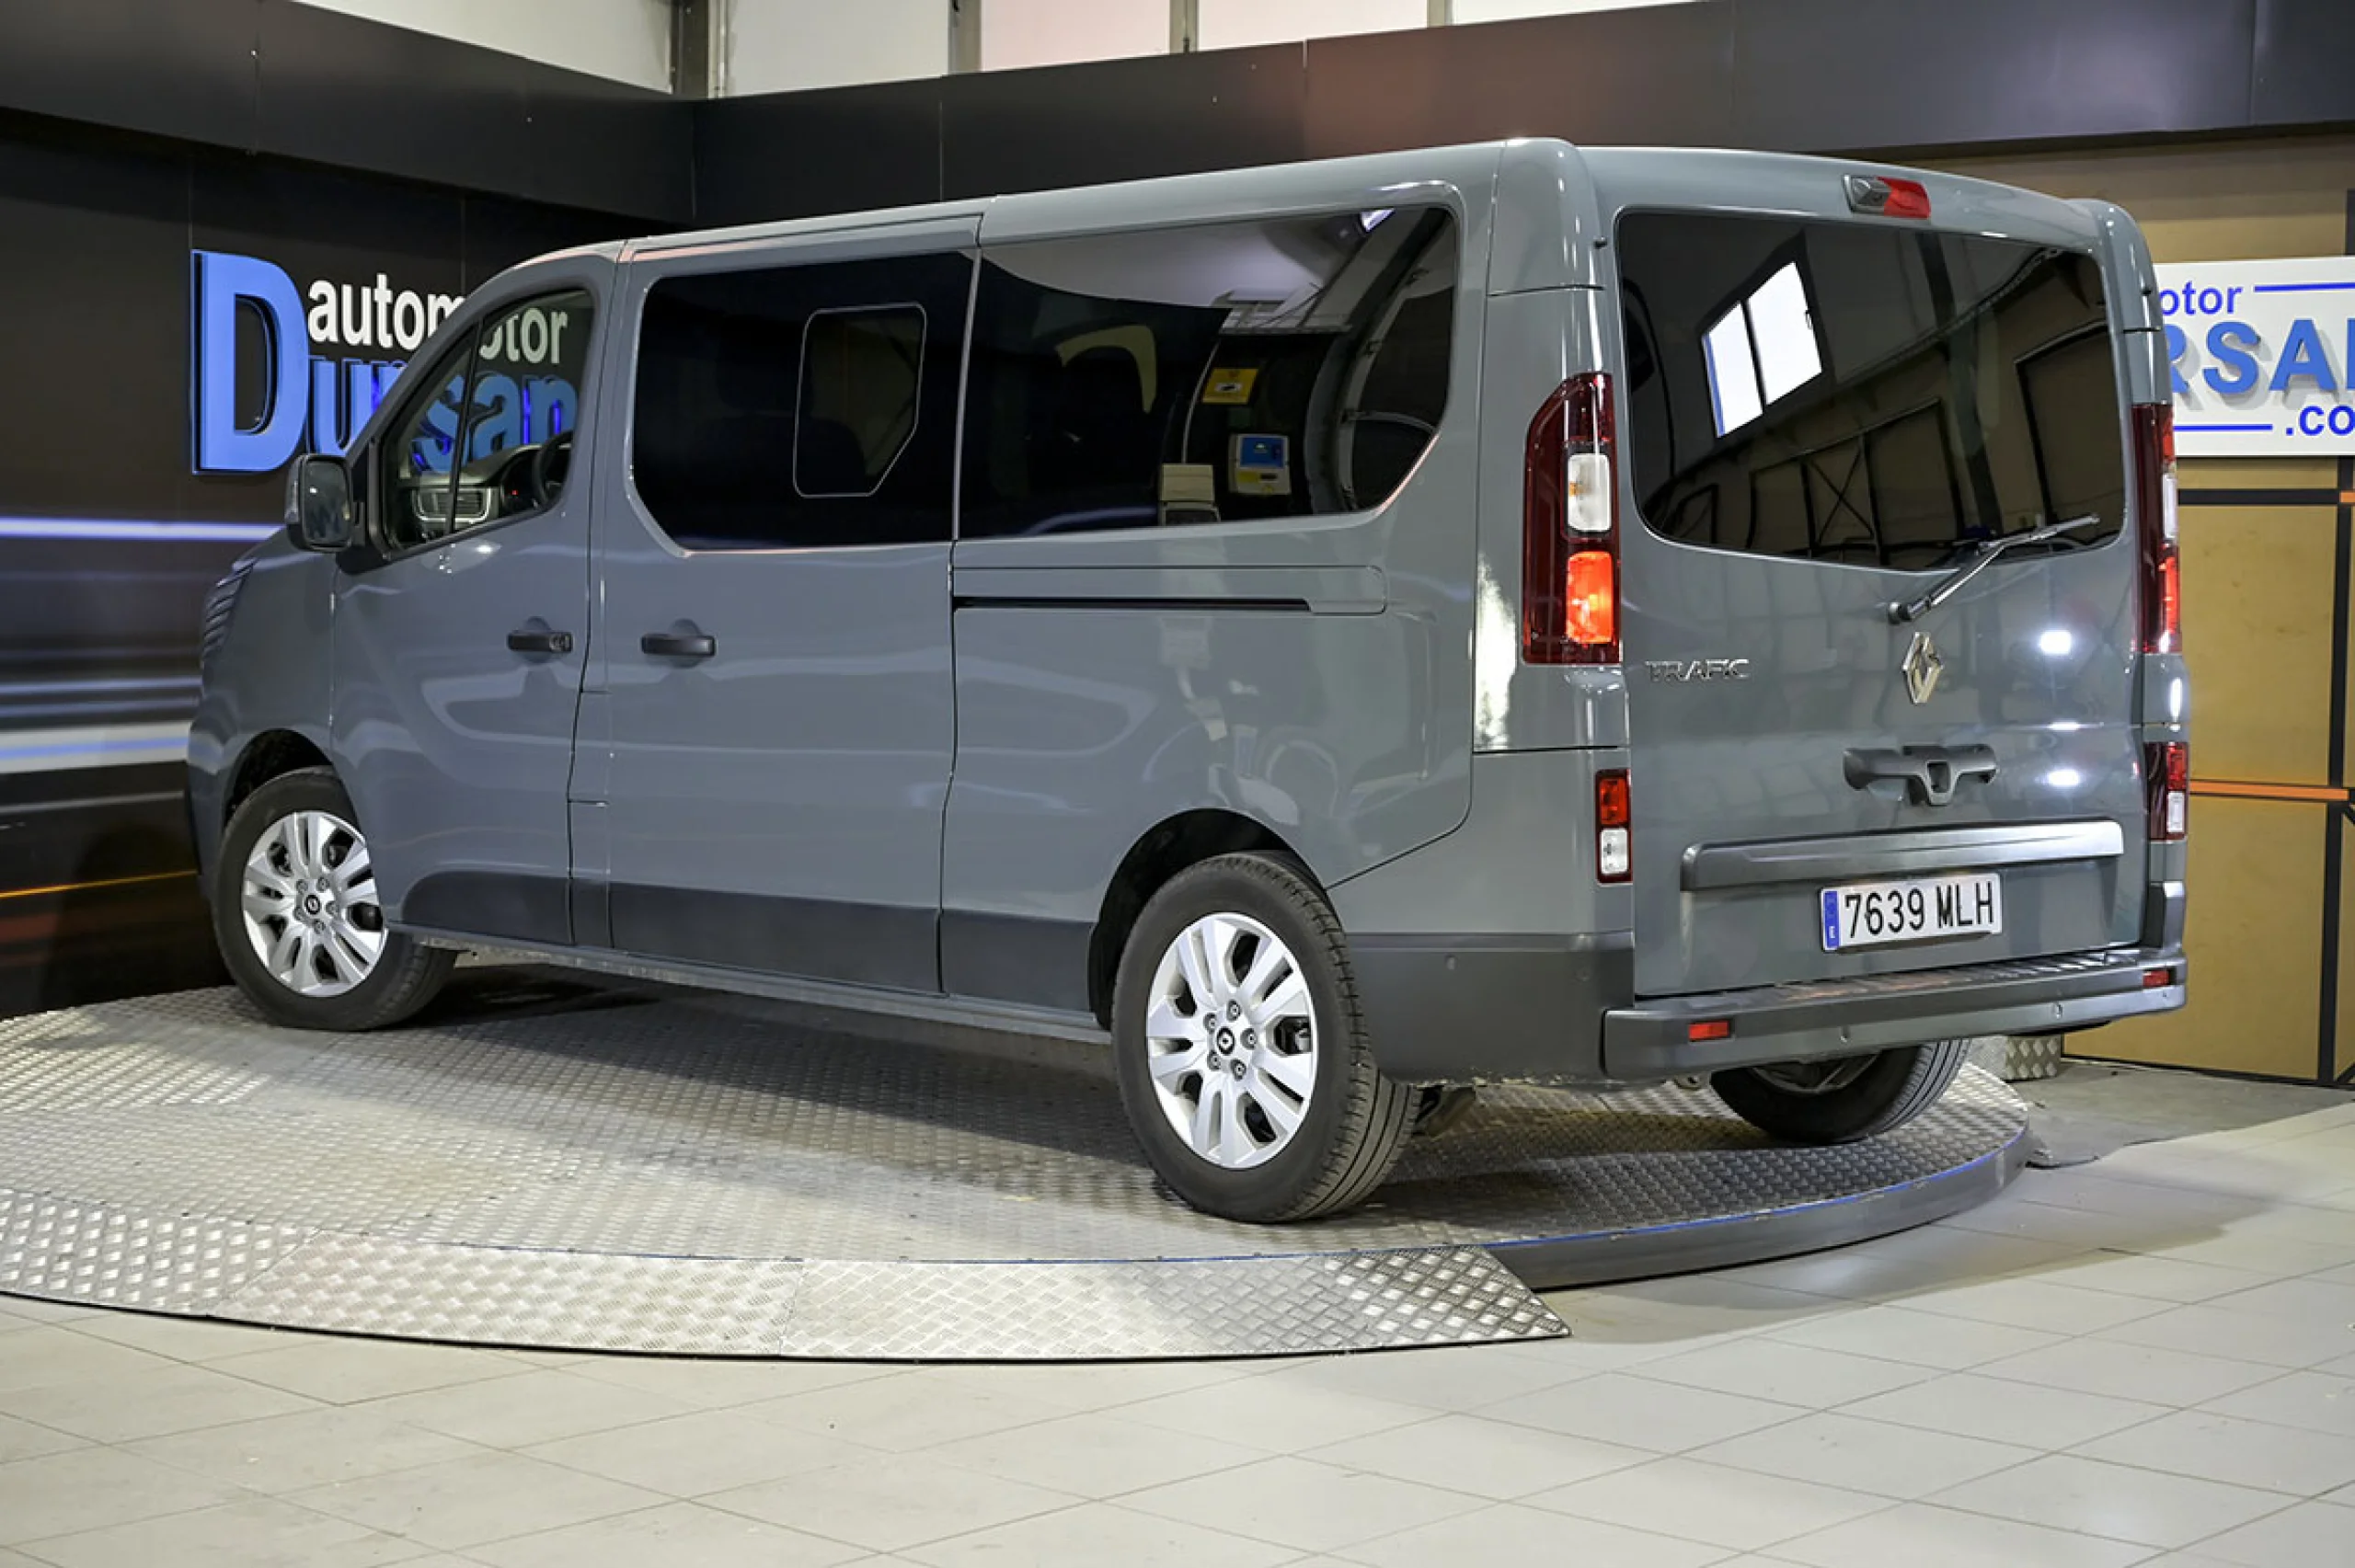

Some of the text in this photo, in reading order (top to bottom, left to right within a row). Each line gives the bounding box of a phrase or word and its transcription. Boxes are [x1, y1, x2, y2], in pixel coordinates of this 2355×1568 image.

[2165, 318, 2355, 394] SA
[1645, 659, 1749, 681] TRAFIC
[1844, 880, 1993, 939] 7639 MLH
